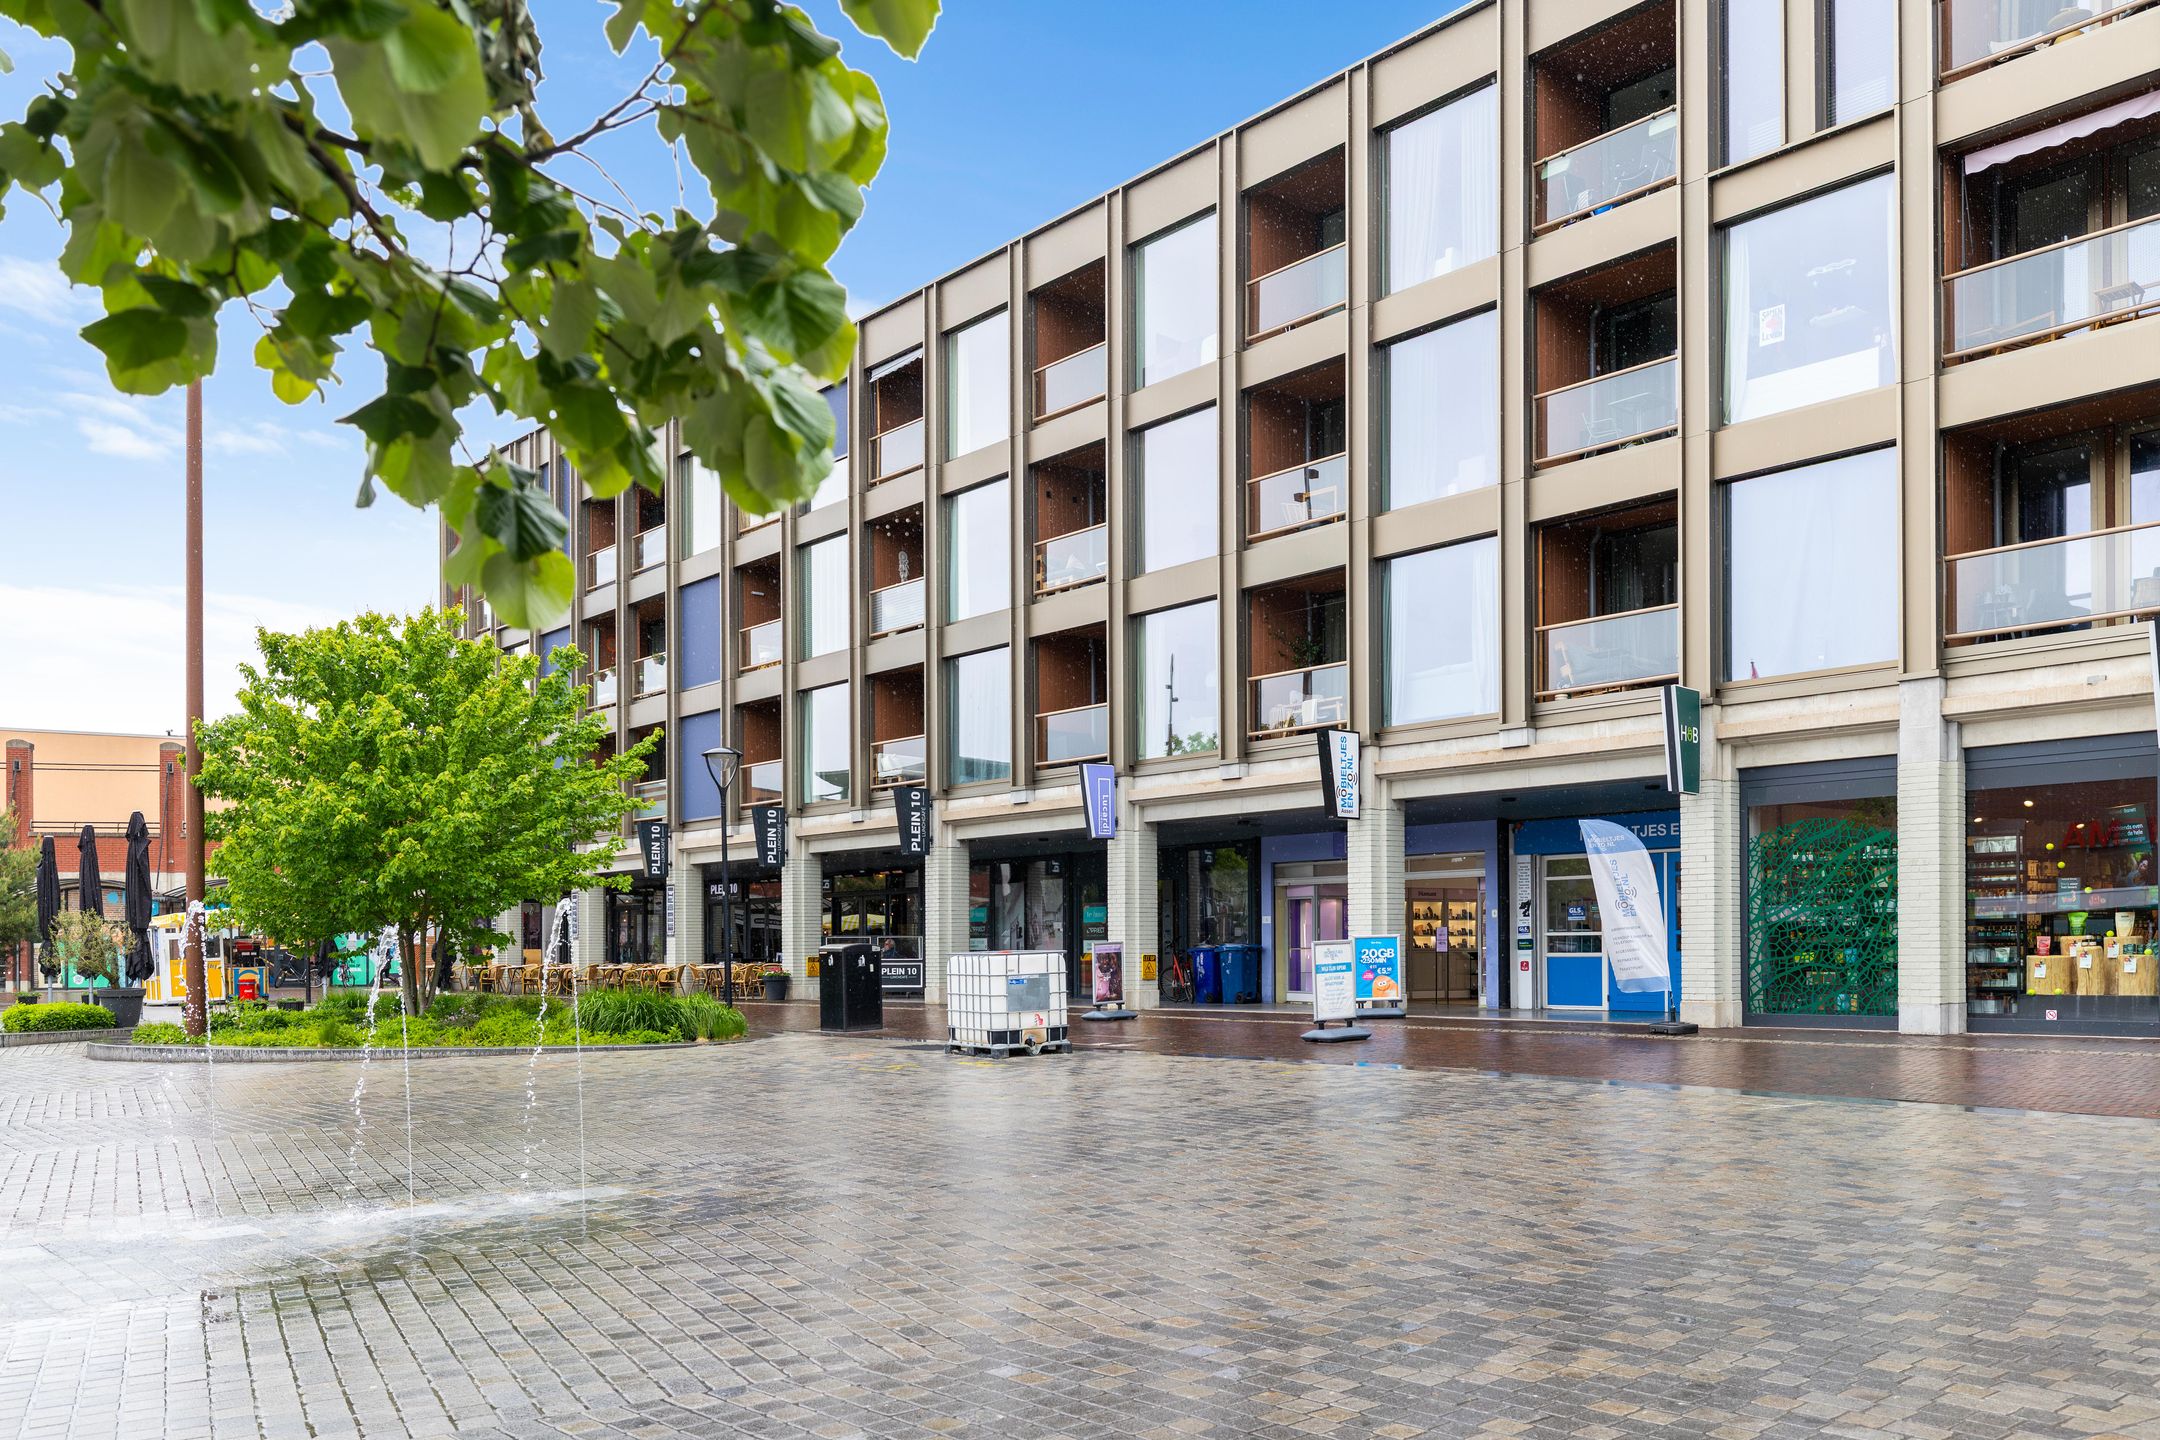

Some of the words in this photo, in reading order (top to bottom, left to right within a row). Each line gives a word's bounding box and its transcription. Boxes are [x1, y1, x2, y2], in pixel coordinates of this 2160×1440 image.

[911, 791, 921, 808] 10
[1347, 793, 1354, 808] EN
[767, 809, 777, 825] 10
[1102, 794, 1110, 832] Lucardi
[651, 825, 661, 839] 10
[911, 811, 921, 851] PLEIN
[767, 828, 777, 864] PLEIN
[651, 842, 661, 875] PLEIN
[729, 883, 738, 894] 10
[1361, 948, 1395, 959] 20GB
[881, 967, 905, 976] PLEIN
[907, 967, 917, 975] 10
